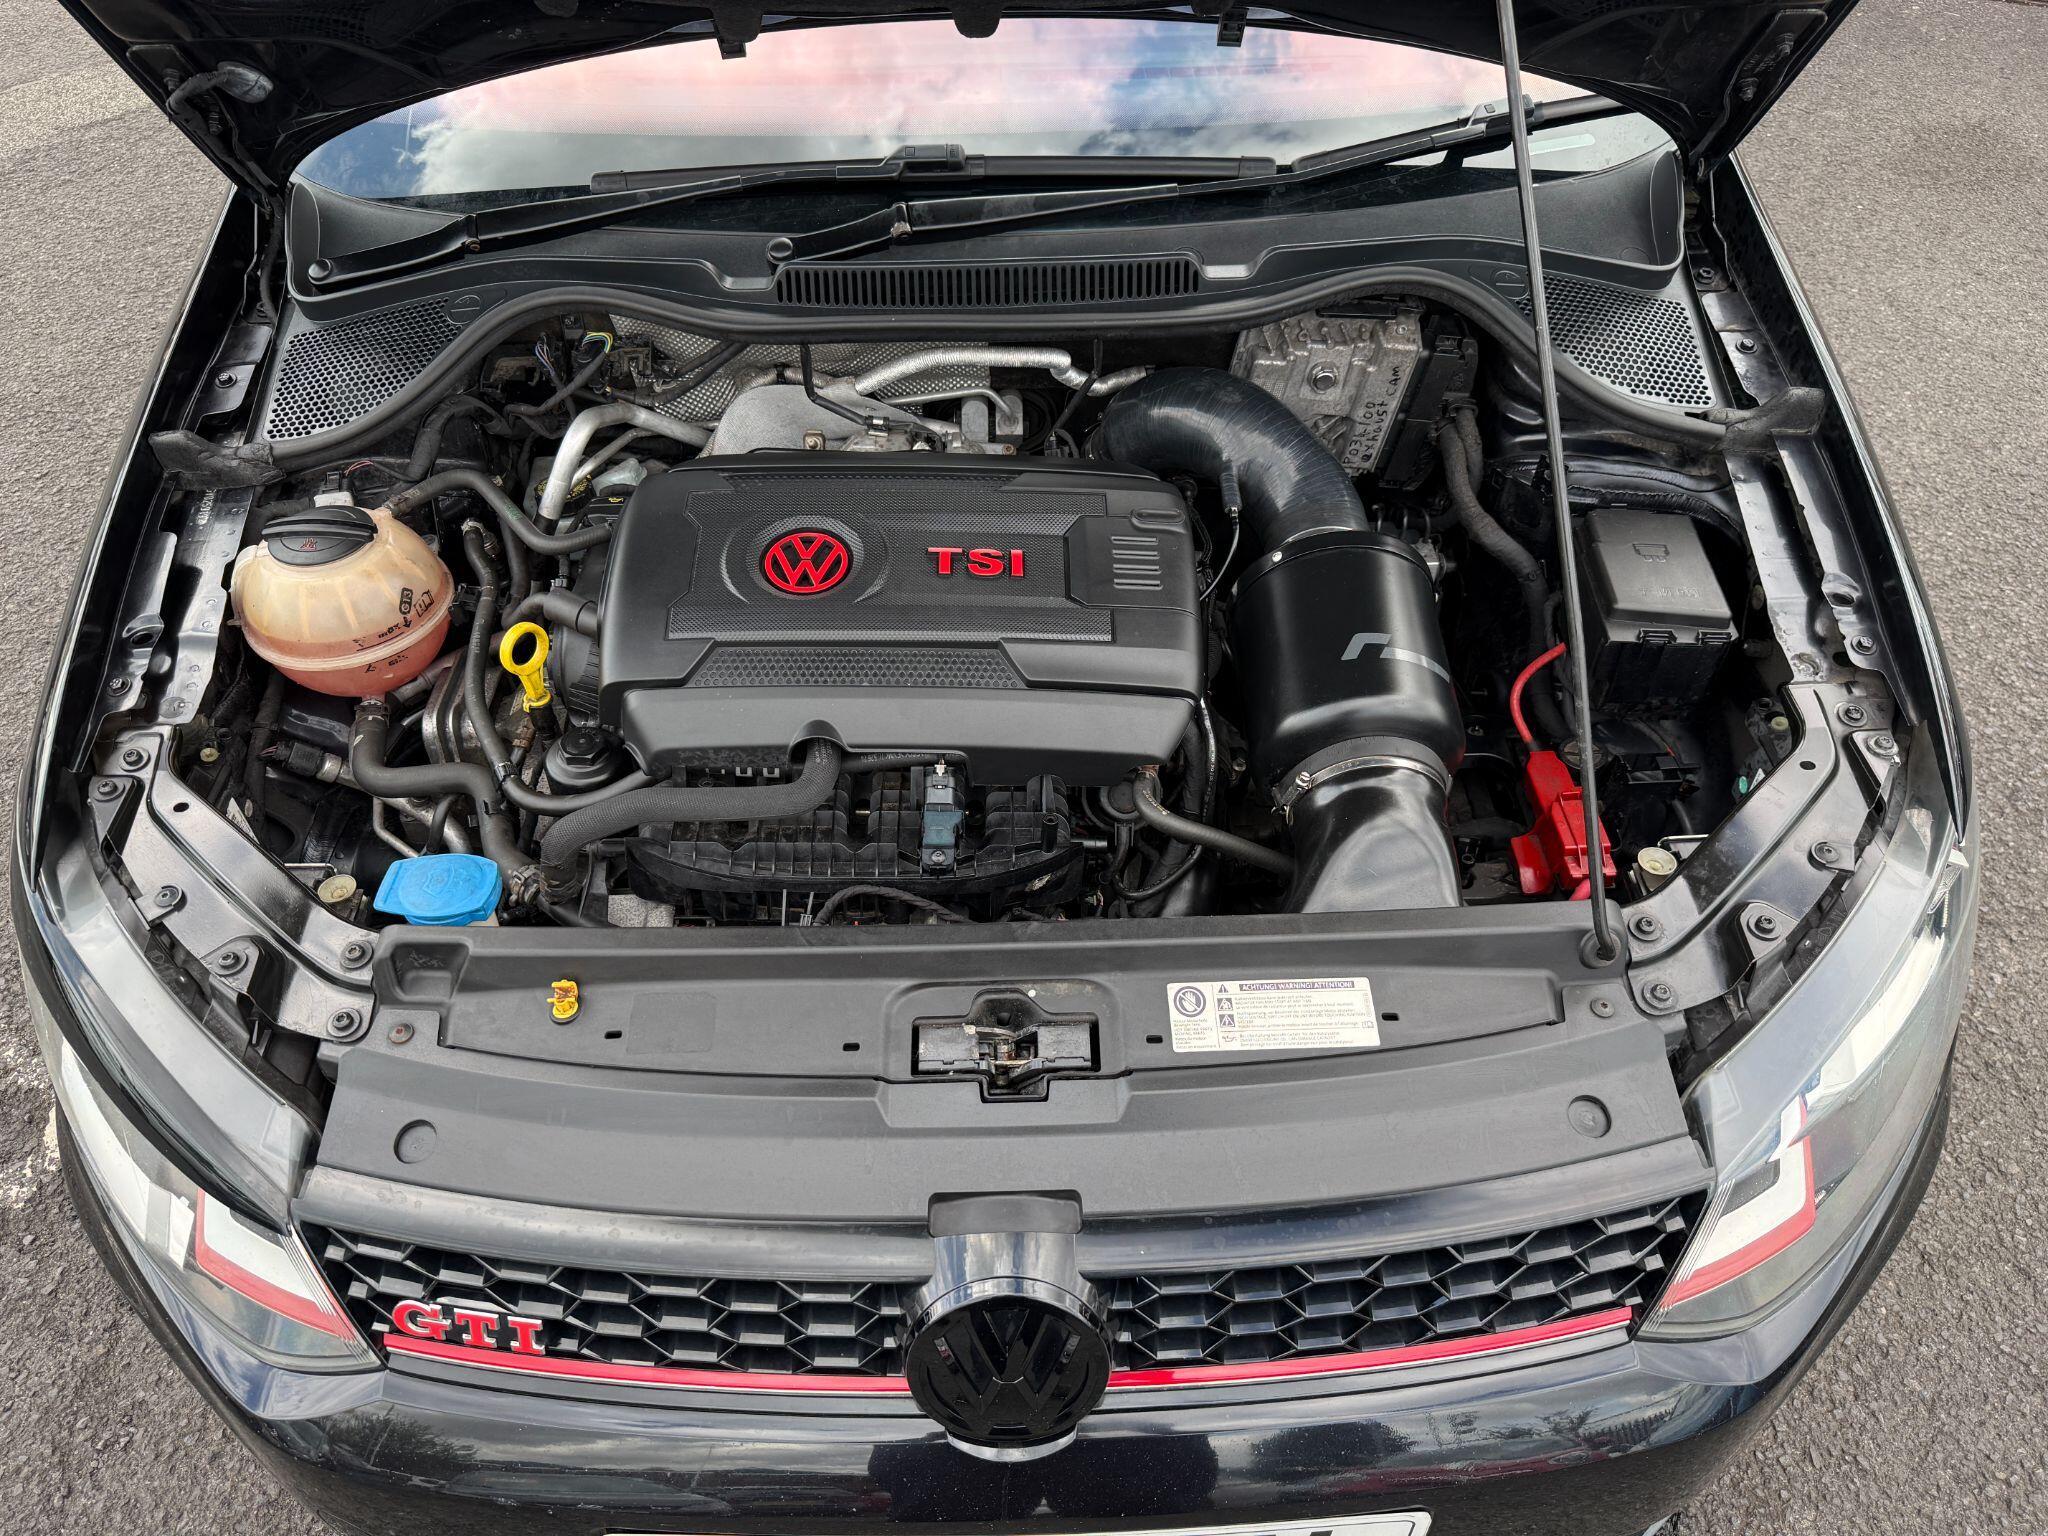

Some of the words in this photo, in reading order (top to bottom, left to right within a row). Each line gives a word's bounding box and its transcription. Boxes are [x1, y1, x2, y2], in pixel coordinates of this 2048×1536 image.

[1360, 400, 1389, 463] exhaust
[928, 547, 1024, 577] TSI
[392, 1299, 545, 1356] GTI
